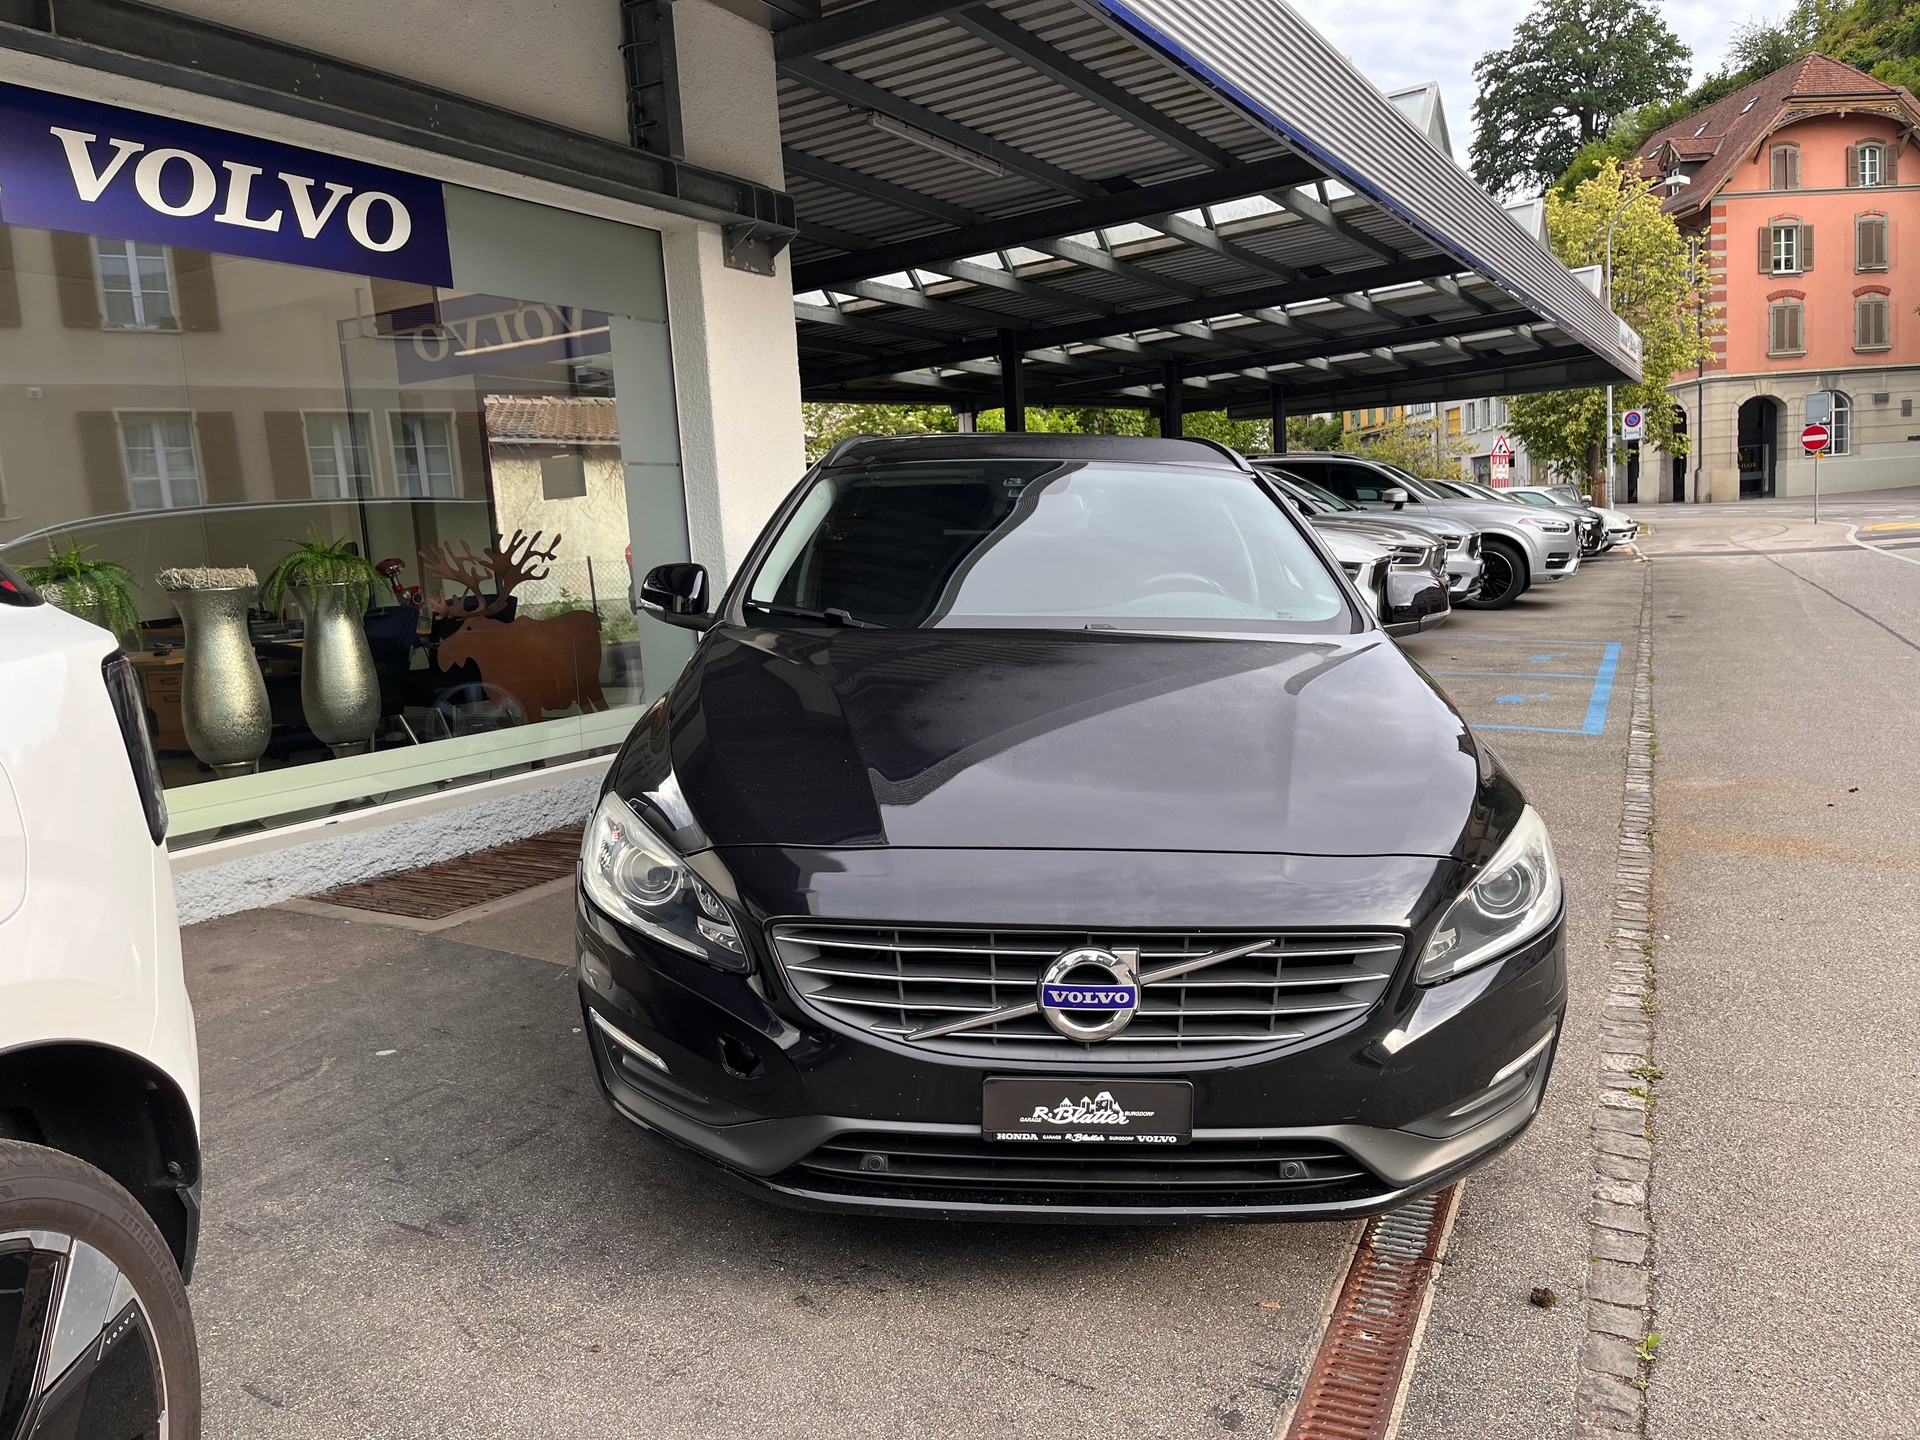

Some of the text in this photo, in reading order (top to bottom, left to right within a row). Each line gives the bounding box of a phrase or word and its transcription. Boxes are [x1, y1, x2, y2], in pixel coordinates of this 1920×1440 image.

[50, 126, 412, 252] VOLVO
[1048, 990, 1130, 1004] VOLVO
[996, 1132, 1039, 1141] HONDA
[1136, 1135, 1178, 1143] VOLVO
[106, 1312, 135, 1345] VOLVO
